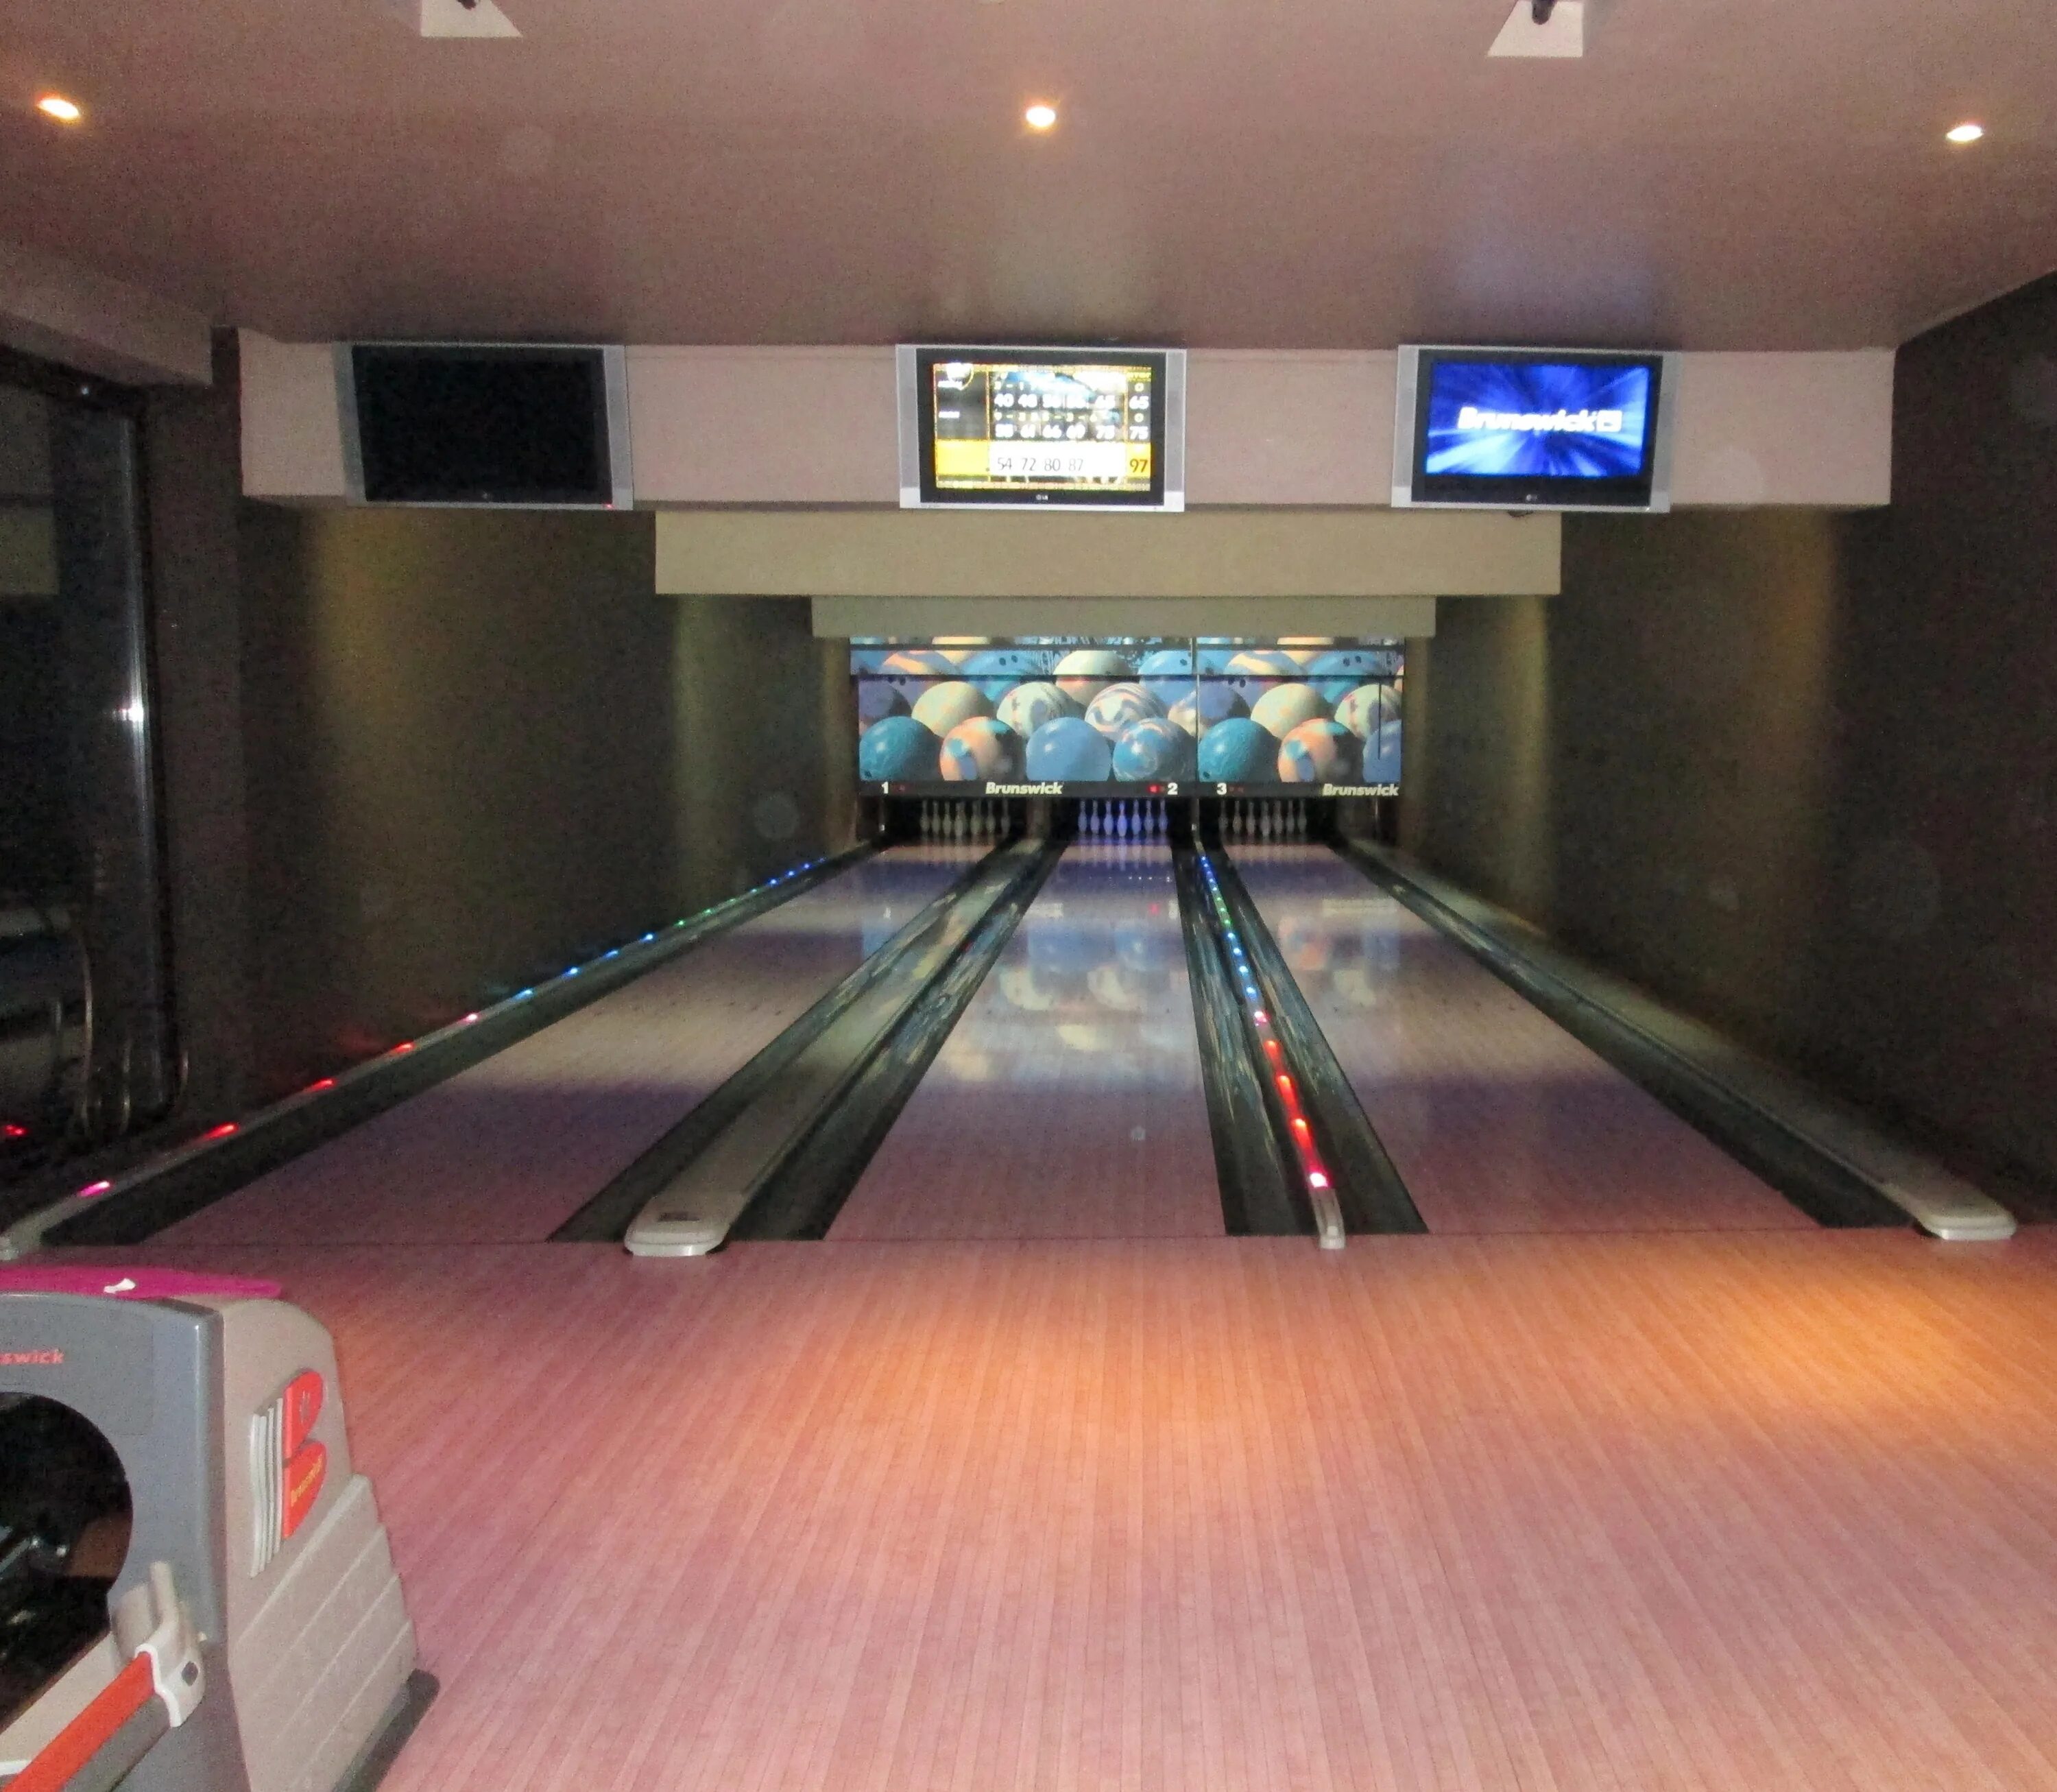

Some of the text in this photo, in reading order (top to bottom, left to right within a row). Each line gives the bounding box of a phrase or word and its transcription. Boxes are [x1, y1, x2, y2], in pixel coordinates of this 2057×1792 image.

[1129, 395, 1149, 409] 65
[1129, 426, 1148, 440] 75
[998, 457, 1148, 473] 54 72 80 87 97
[881, 782, 889, 794] 1
[985, 782, 1063, 795] Brunswick
[1167, 782, 1178, 796] 2
[1216, 782, 1227, 796] 3
[1323, 783, 1399, 796] Brunswick
